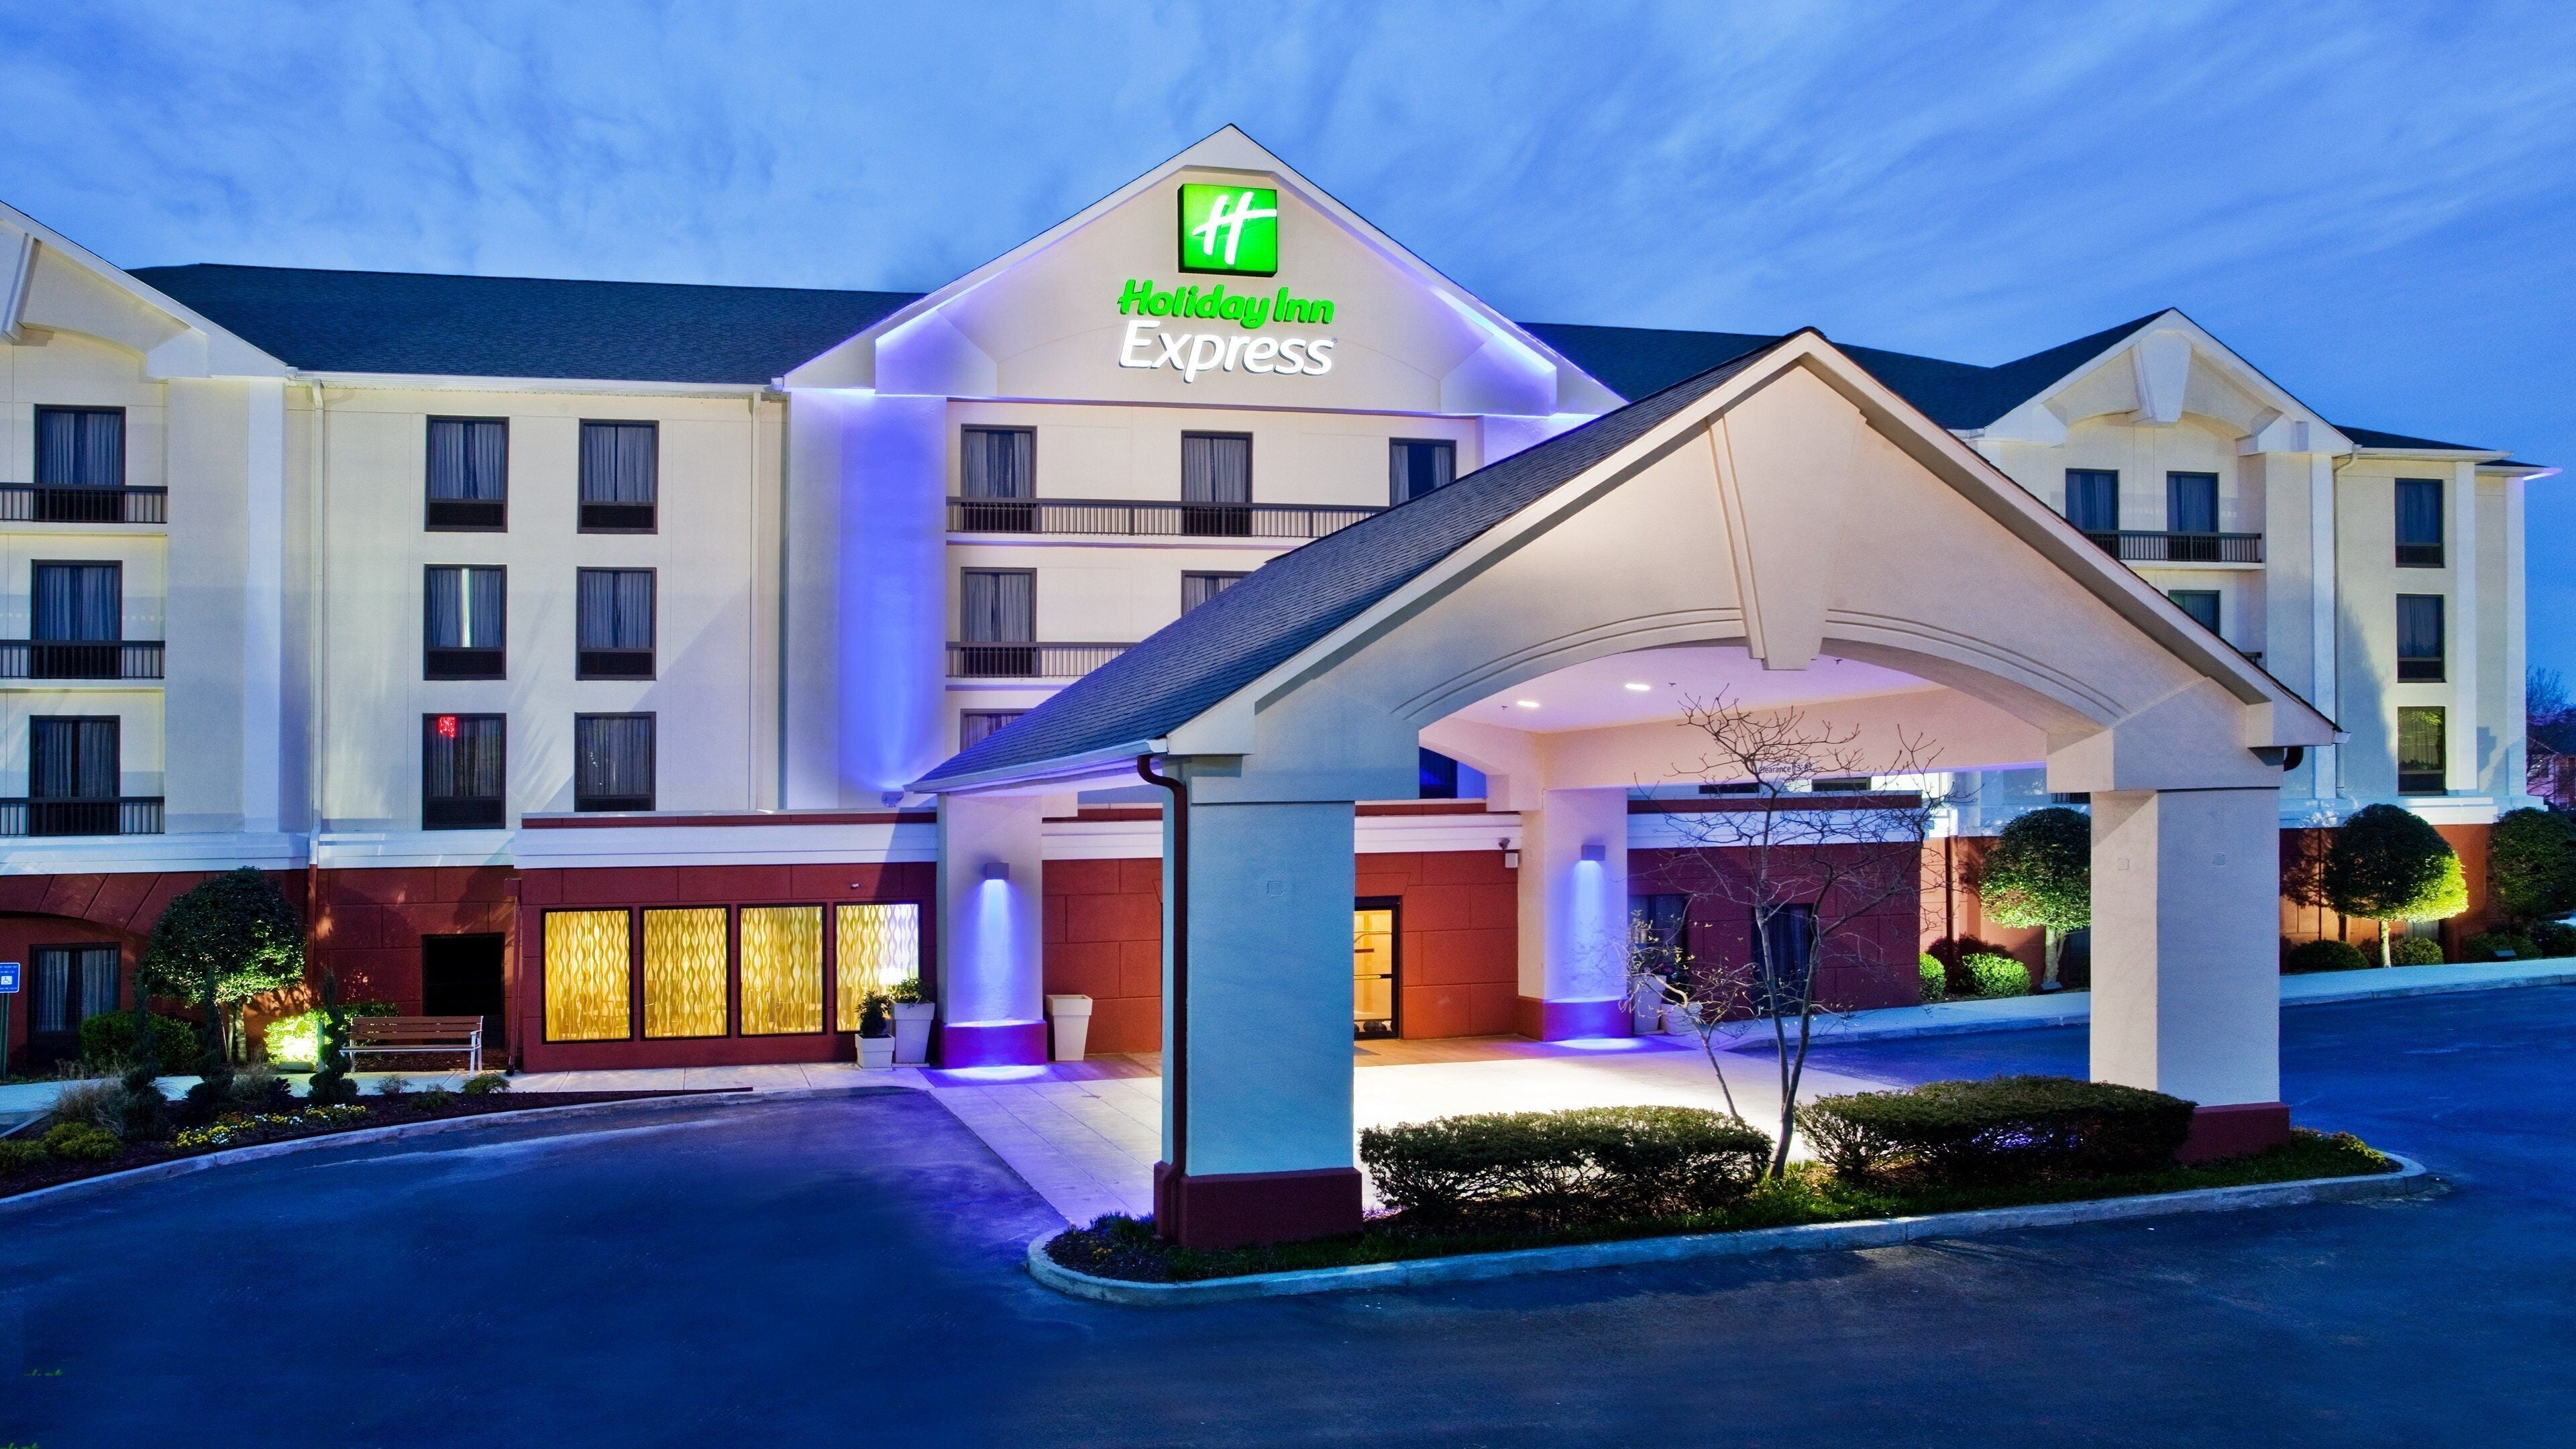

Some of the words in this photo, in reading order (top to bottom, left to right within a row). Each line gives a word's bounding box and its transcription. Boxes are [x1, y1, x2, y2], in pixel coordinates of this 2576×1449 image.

[1191, 191, 1277, 265] H
[1117, 279, 1270, 329] Holiday
[1274, 287, 1335, 324] Inn
